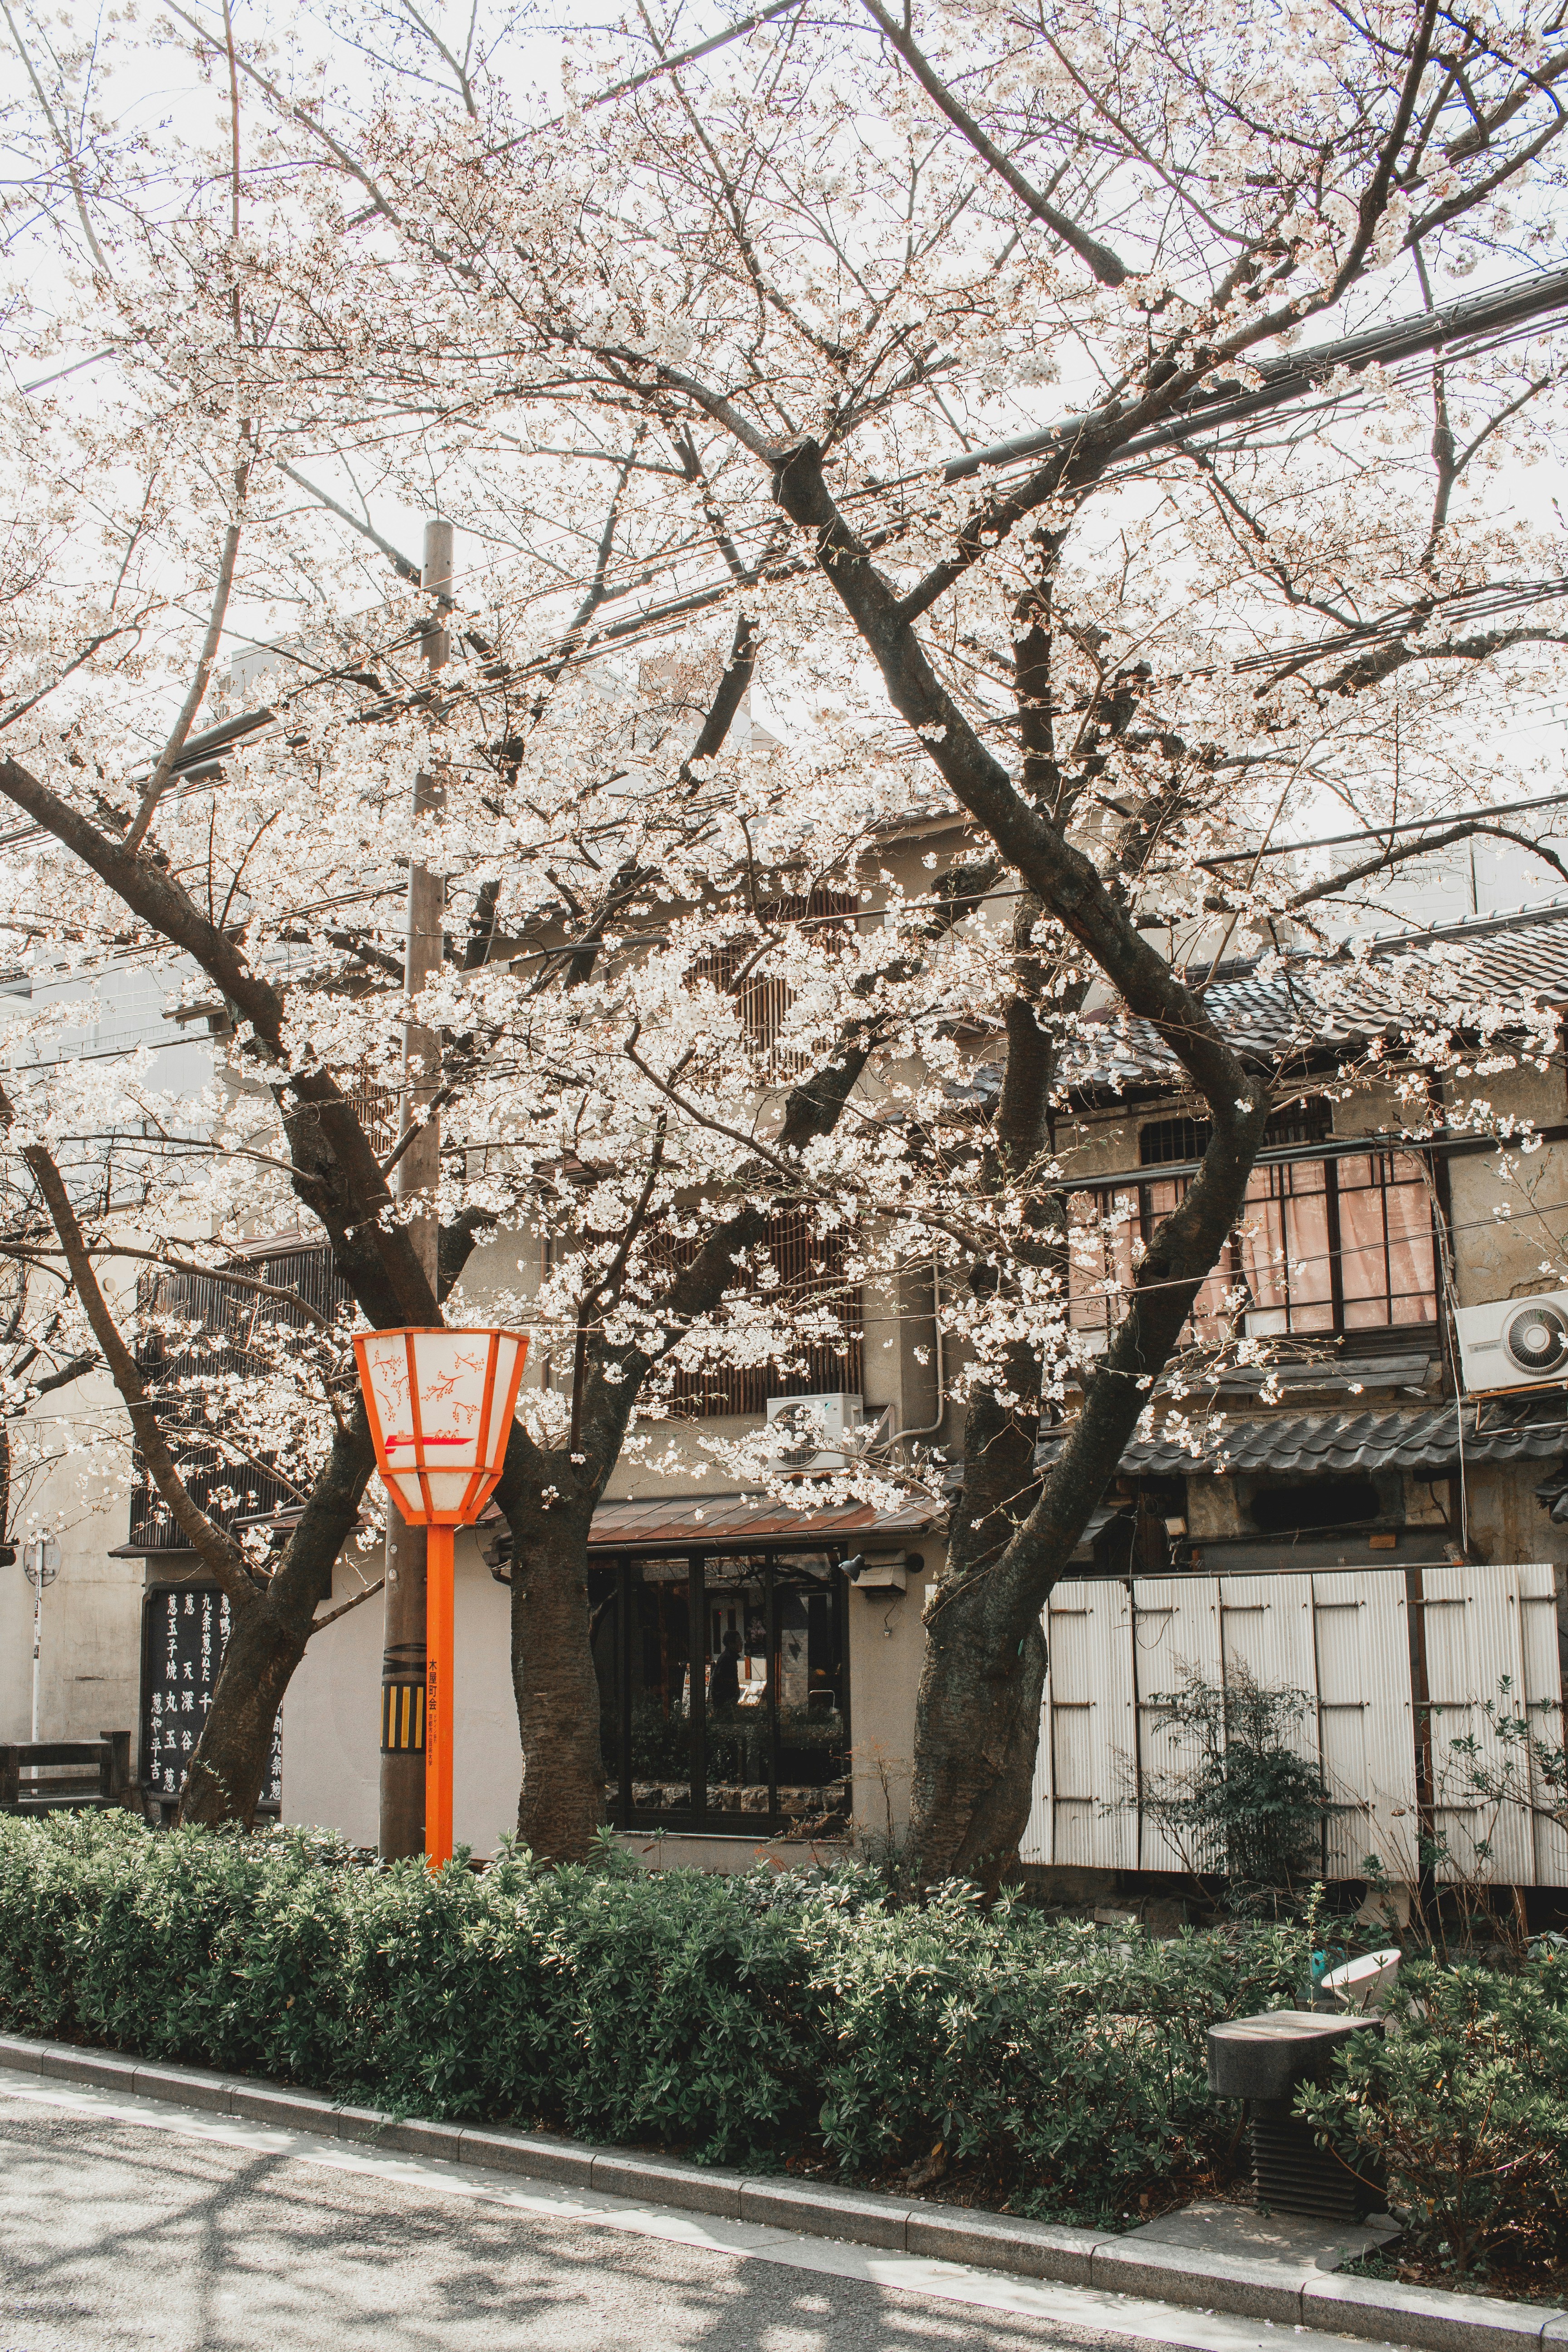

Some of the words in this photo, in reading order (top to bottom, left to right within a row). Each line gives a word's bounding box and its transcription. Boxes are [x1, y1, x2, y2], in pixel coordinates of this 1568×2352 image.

[166, 1594, 178, 1680] 葱玉子焼
[201, 1593, 212, 1681] 九条葱ぬた
[429, 1659, 437, 1710] 木屋町会
[151, 1692, 163, 1779] 葱や平吉
